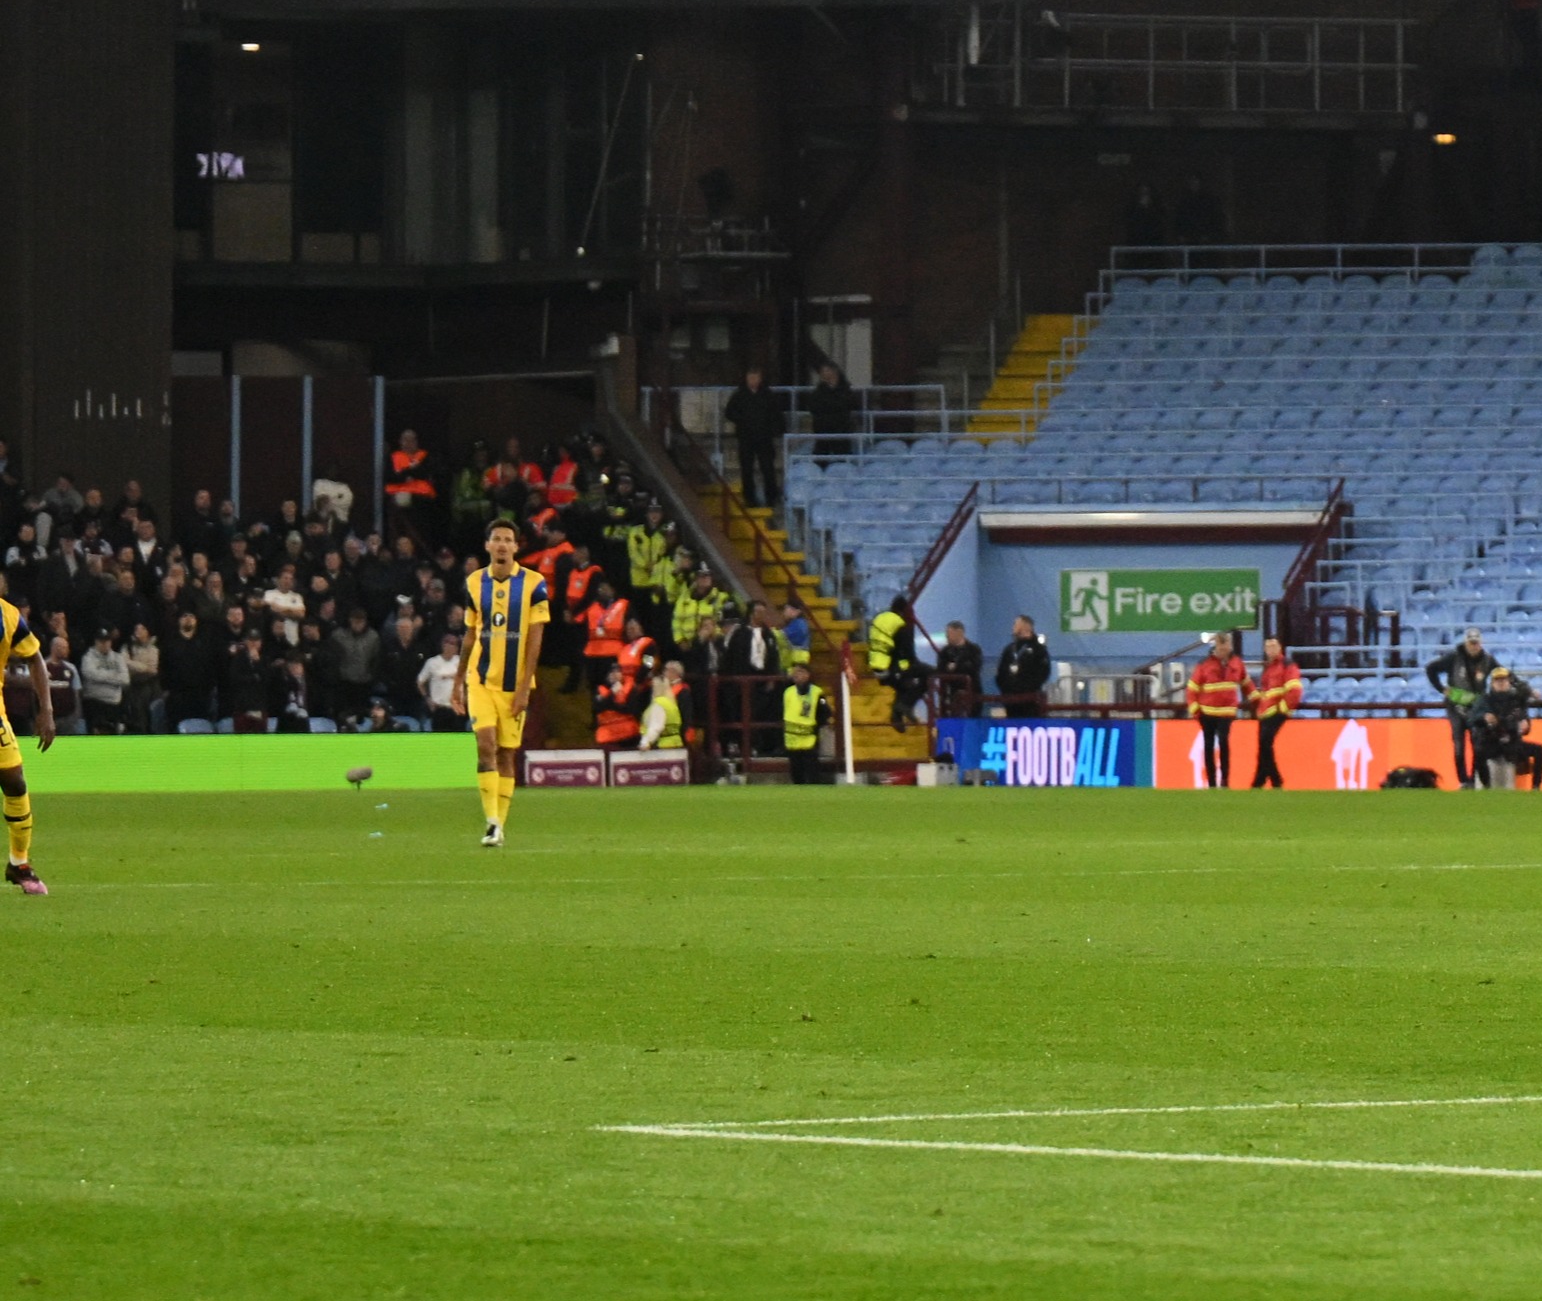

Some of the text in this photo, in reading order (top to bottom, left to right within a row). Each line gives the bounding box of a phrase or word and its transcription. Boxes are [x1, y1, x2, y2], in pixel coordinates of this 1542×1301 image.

[1114, 585, 1257, 614] Fire exit
[979, 726, 1120, 787] #FOOTBALL
